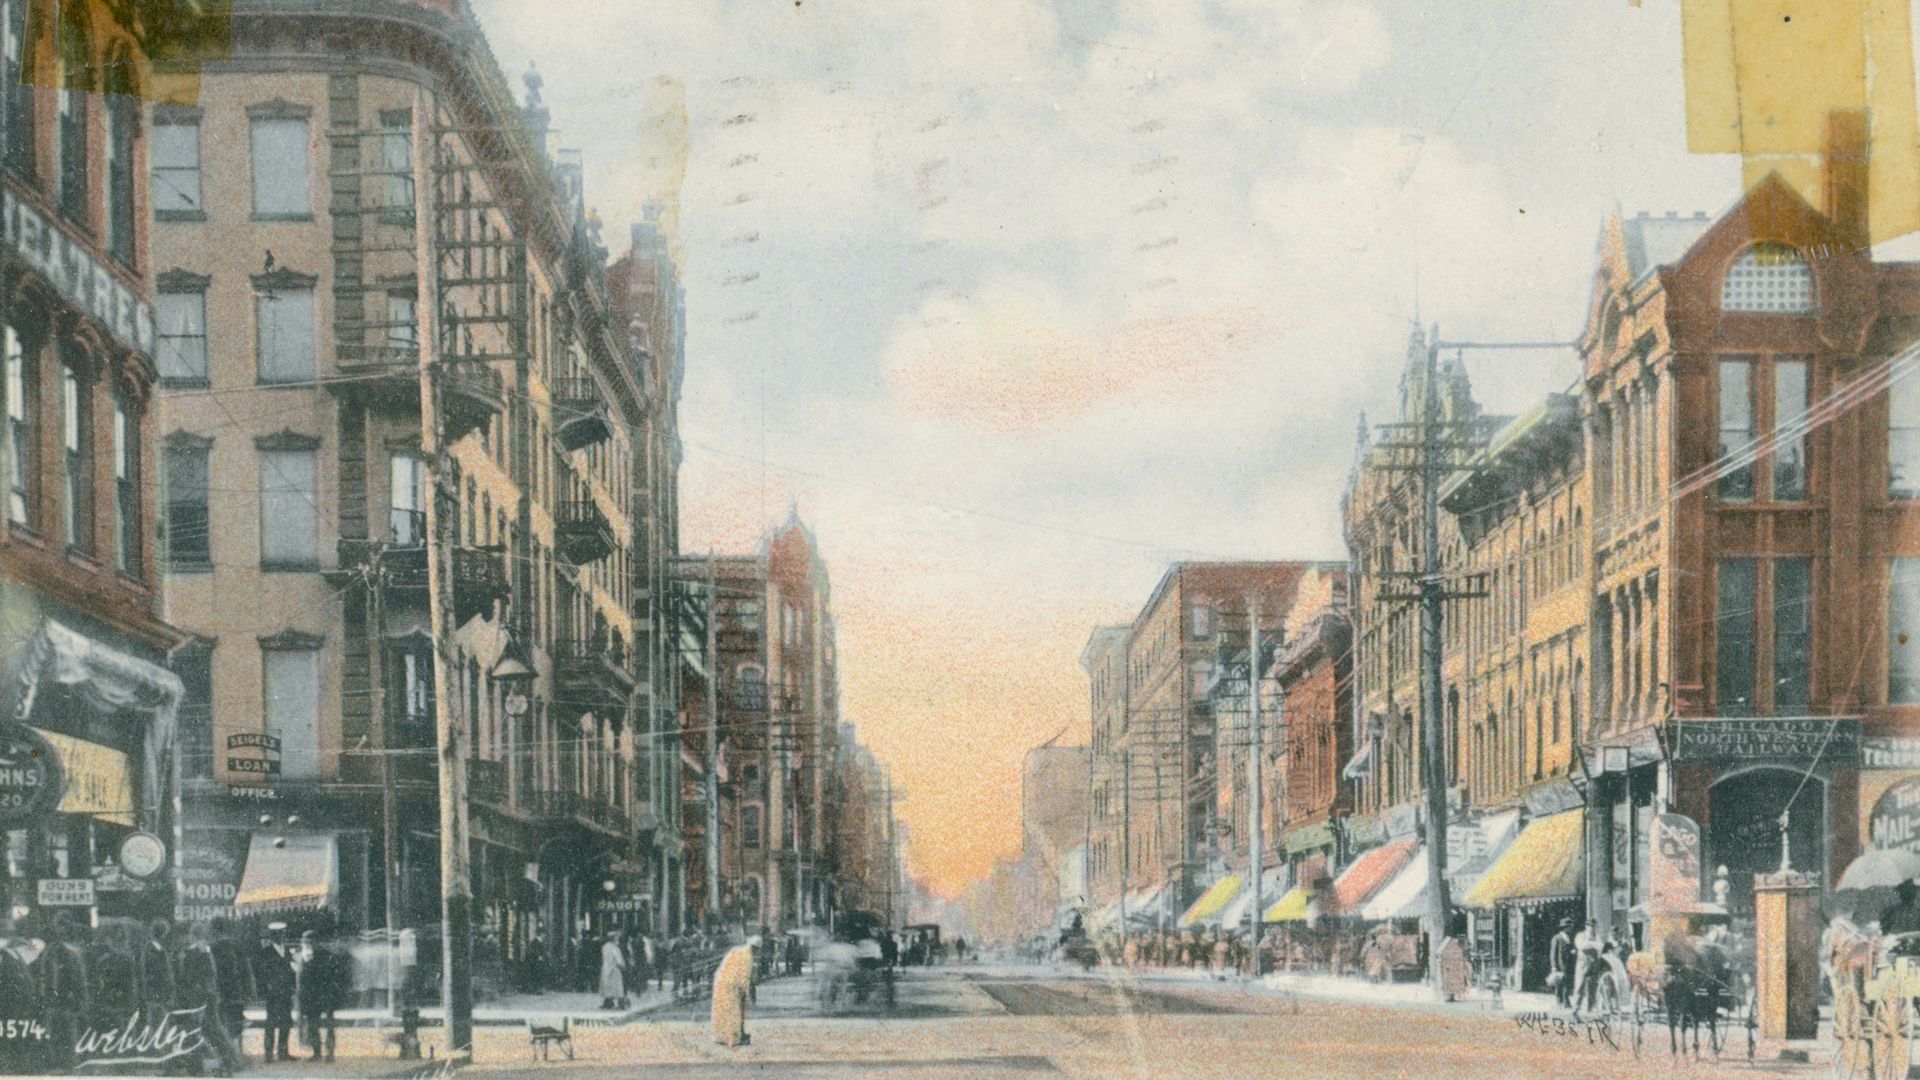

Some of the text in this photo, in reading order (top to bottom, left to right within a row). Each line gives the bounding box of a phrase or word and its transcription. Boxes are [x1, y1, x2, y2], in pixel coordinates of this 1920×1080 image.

[236, 760, 271, 772] LOAN
[45, 881, 87, 891] GUNS
[41, 891, 63, 900] FOR
